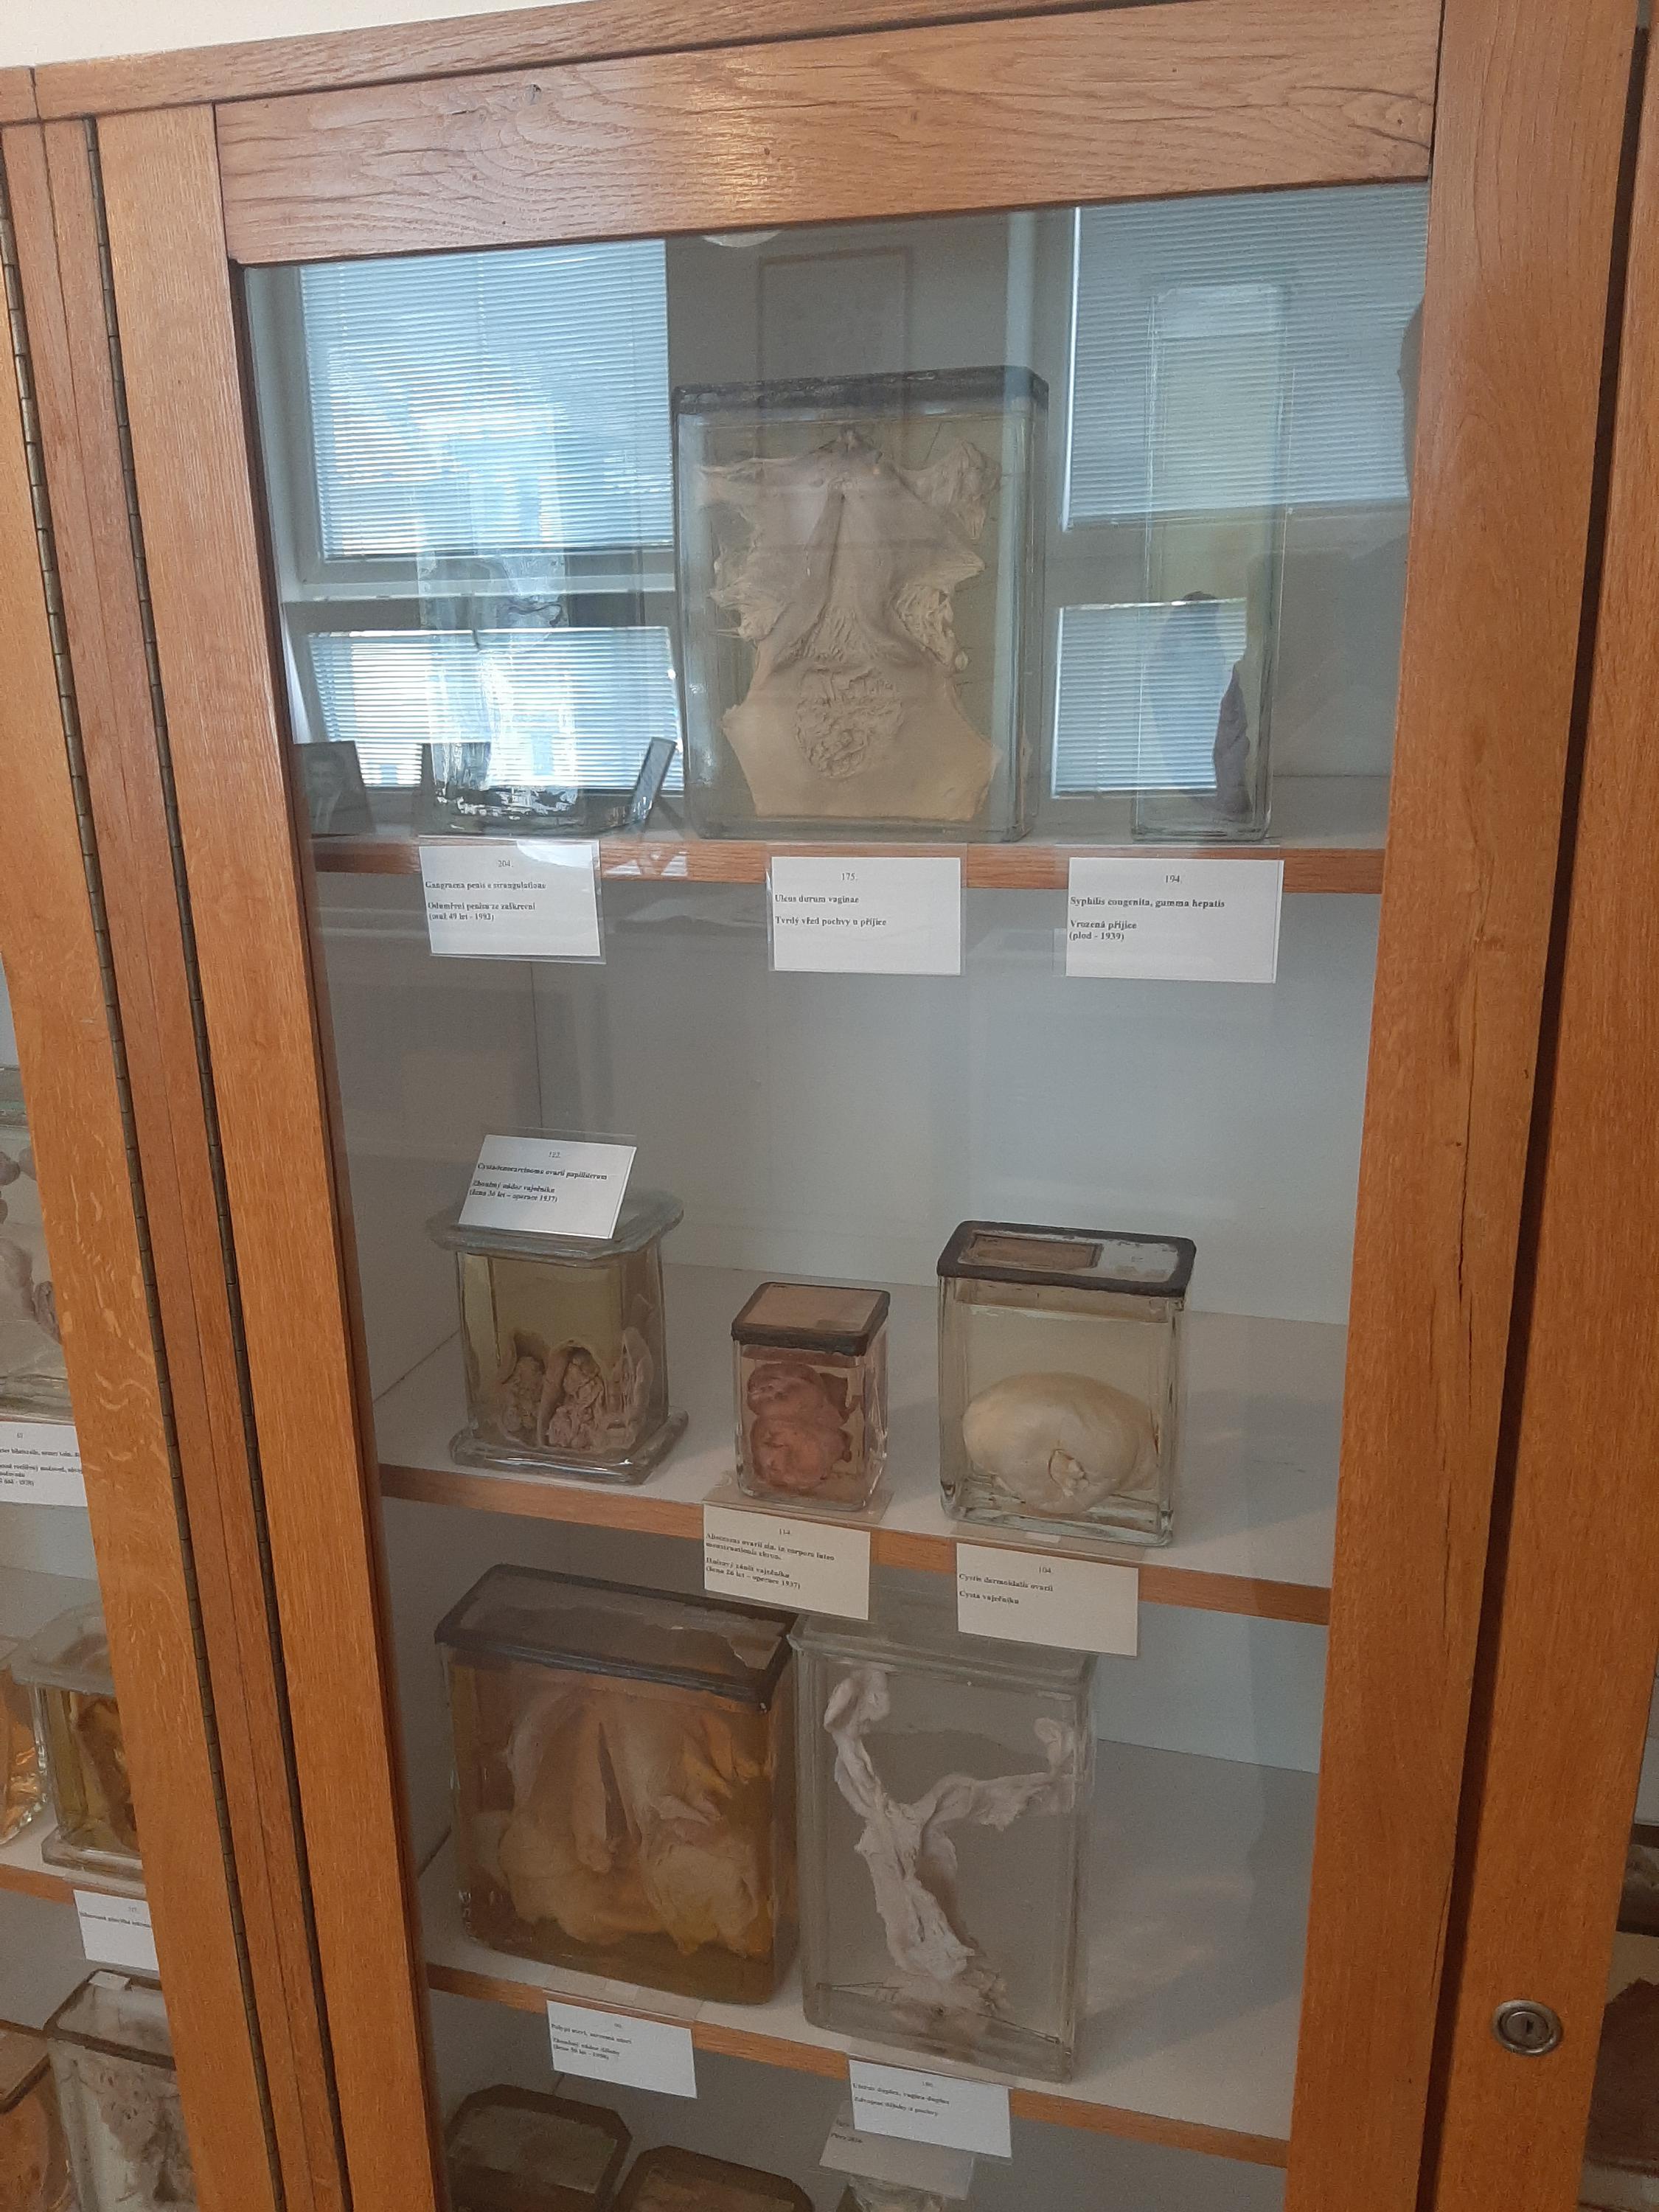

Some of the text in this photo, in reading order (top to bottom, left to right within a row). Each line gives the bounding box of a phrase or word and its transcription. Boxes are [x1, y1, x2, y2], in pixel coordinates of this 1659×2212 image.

[841, 872, 858, 881] 175.
[829, 896, 859, 904] vaginae
[1070, 896, 1225, 908] Syphilis congenita, gumma hepatis
[776, 917, 799, 925] Tvrdý
[822, 917, 850, 926] pochvy
[860, 918, 887, 927] příjice
[1071, 919, 1137, 931] Vrozená příjice
[1069, 931, 1091, 941] (plod
